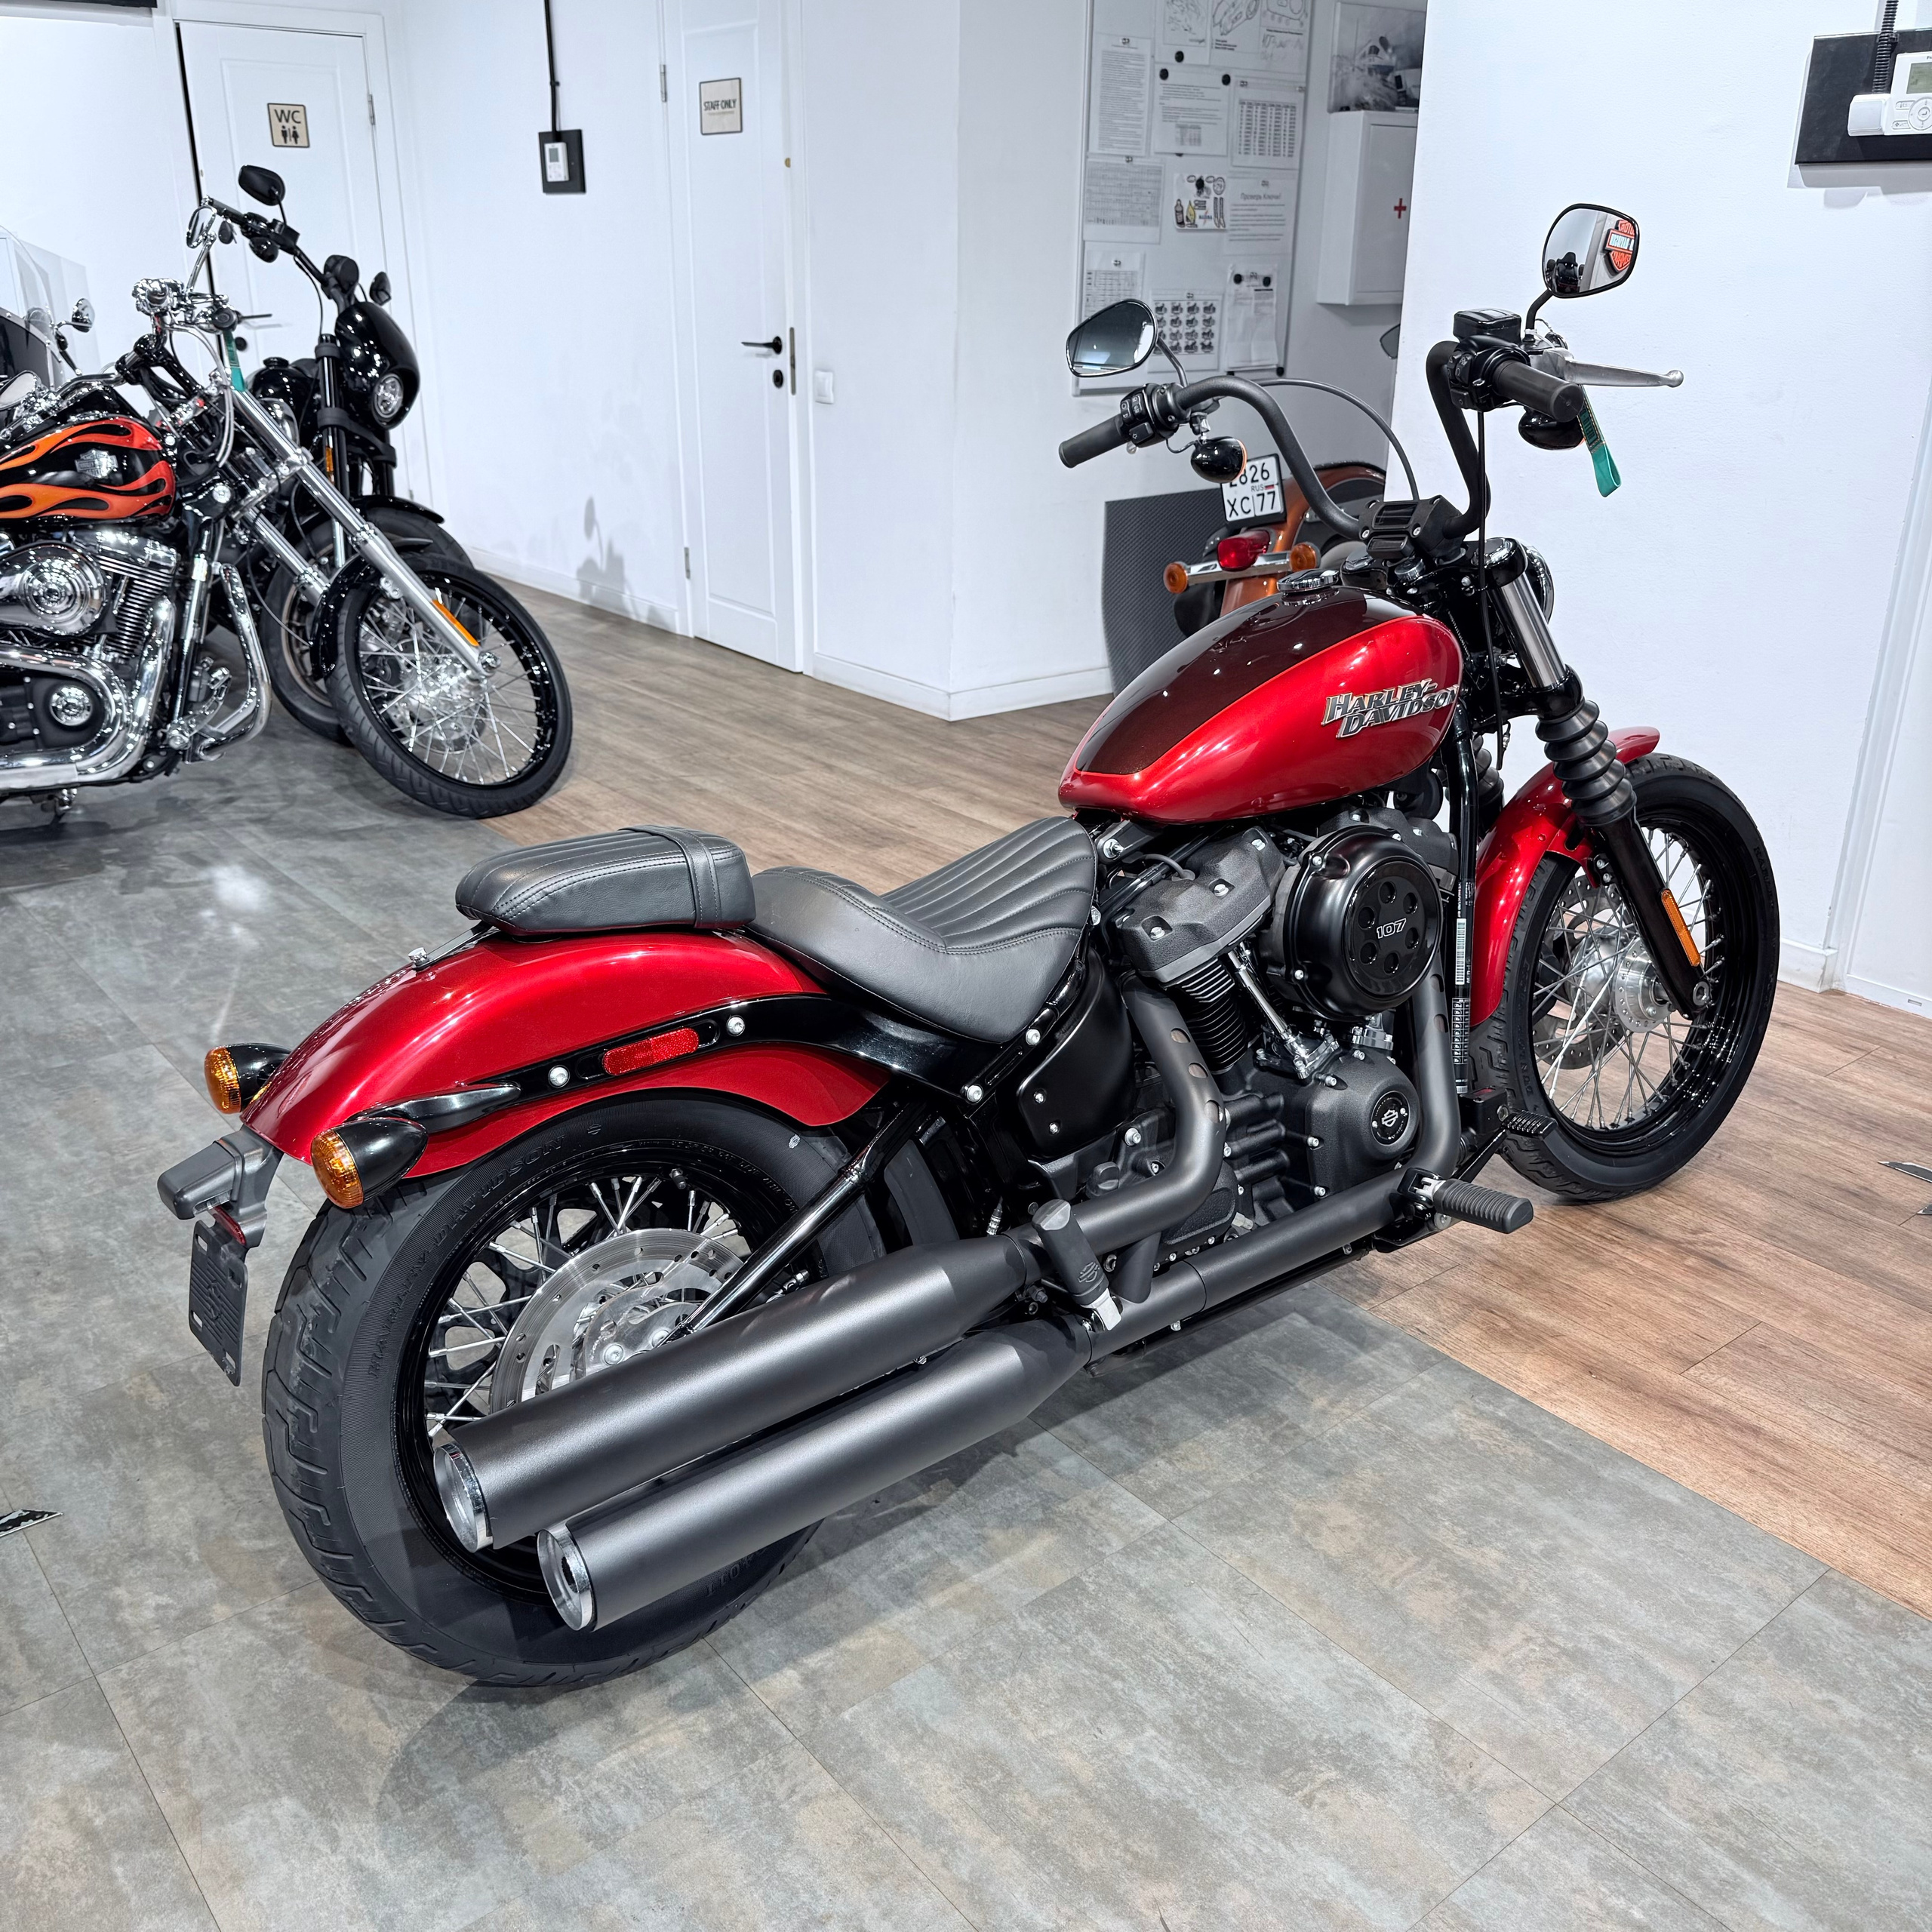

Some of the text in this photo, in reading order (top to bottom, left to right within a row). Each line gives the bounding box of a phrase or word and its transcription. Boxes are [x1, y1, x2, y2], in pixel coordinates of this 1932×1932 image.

[720, 98, 737, 109] ONLY
[273, 109, 301, 124] WC
[1229, 462, 1269, 488] 826
[1251, 484, 1264, 492] RUS
[1257, 491, 1275, 512] 77
[1336, 684, 1460, 739] DAVIDSON
[1377, 918, 1406, 939] 107
